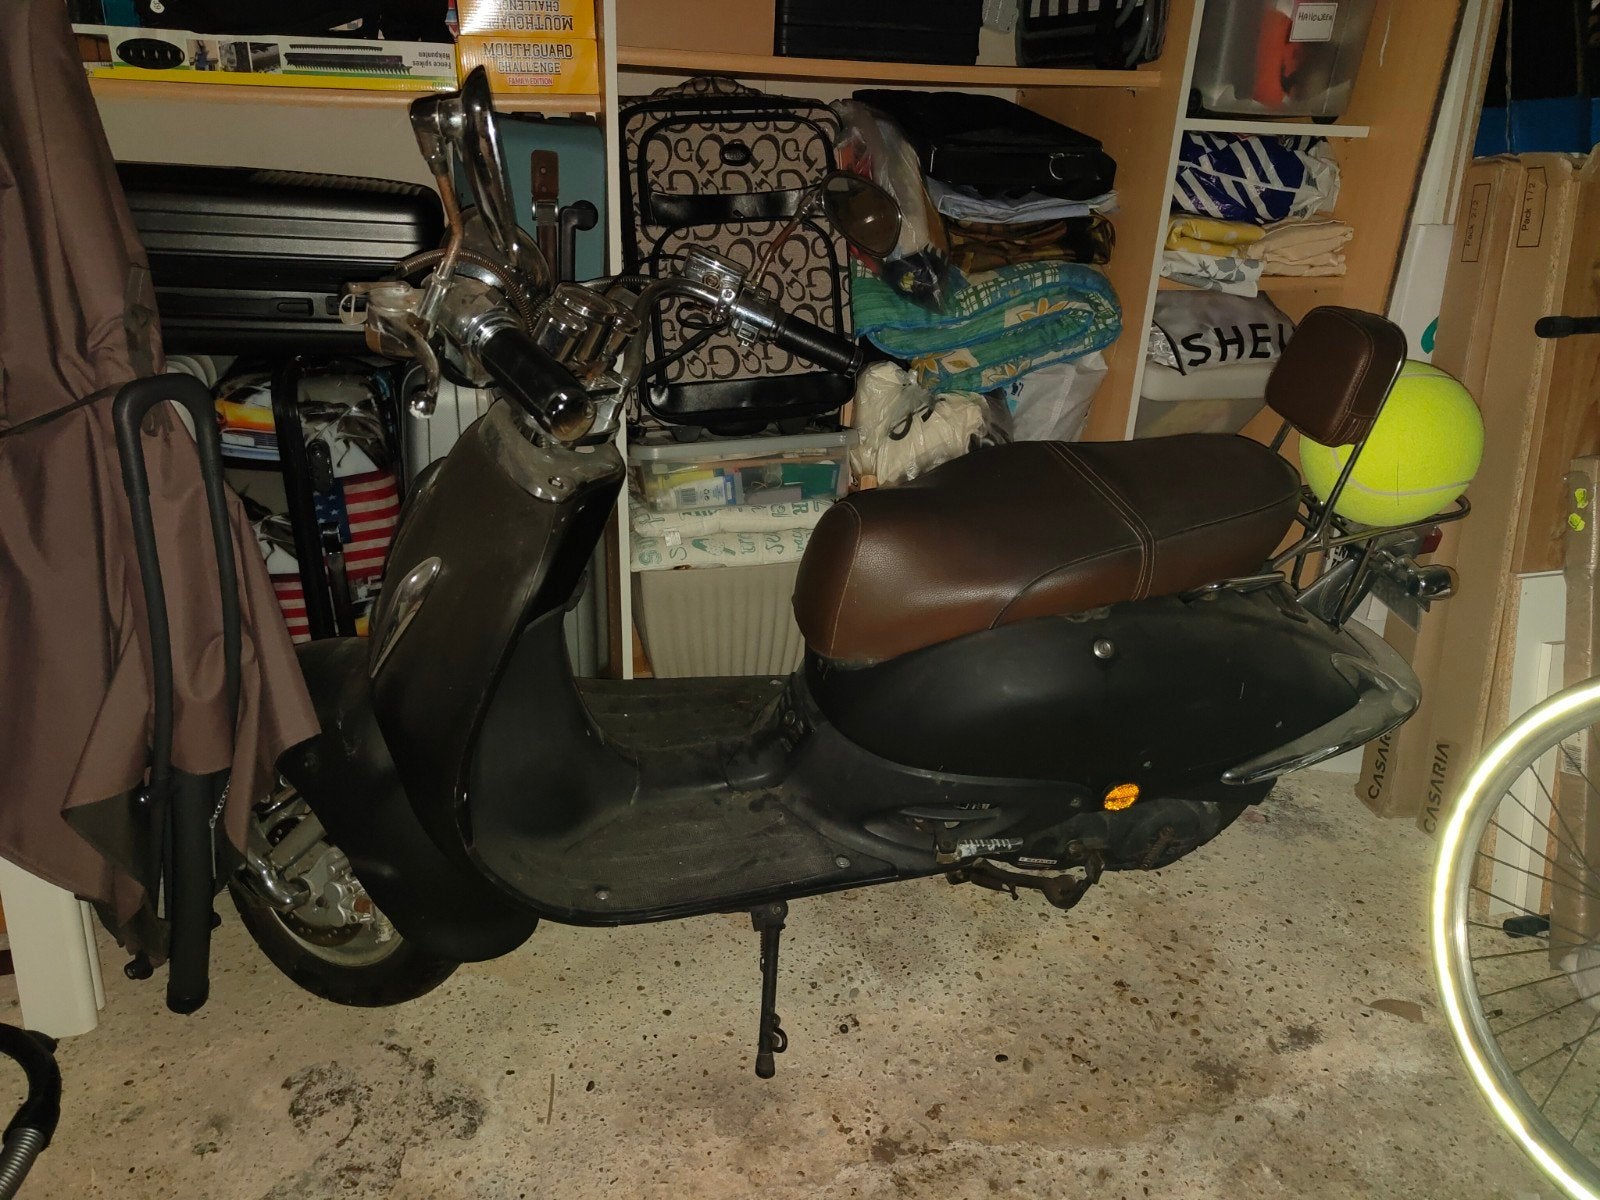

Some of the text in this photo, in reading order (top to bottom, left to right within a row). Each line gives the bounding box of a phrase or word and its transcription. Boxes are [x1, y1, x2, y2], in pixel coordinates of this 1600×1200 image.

[496, 0, 560, 12] CHALLENG
[482, 42, 574, 59] MOUTHGUARD
[412, 60, 452, 70] Fence spikes
[498, 61, 562, 74] CHALLENGE
[508, 77, 553, 86] FAMILY EDITION
[1520, 208, 1532, 231] Pack
[1465, 225, 1475, 247] Pack
[1367, 731, 1392, 800] CASAR
[1423, 743, 1450, 834] CASARIA
